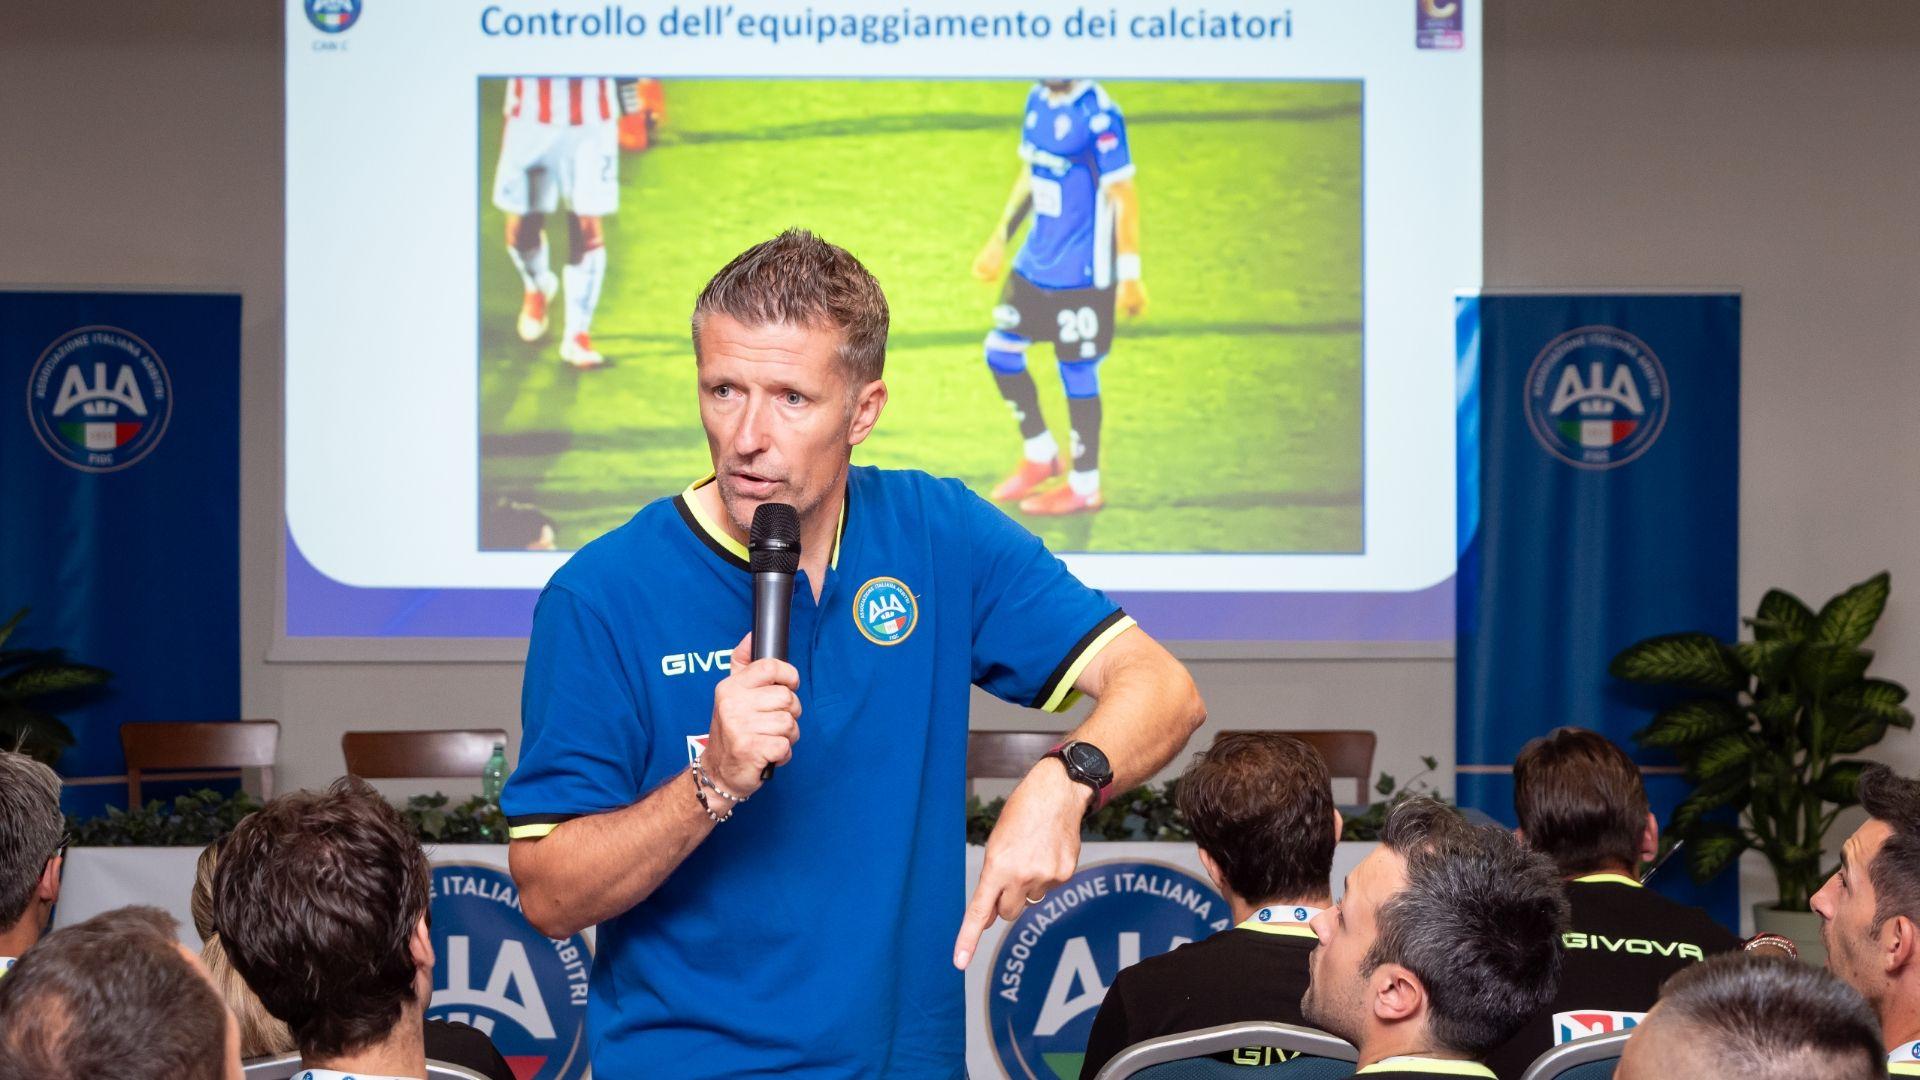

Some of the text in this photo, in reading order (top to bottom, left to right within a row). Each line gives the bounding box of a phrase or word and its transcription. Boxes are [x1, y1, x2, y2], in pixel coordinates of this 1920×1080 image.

[480, 6, 646, 37] Controllo
[1064, 9, 1117, 38] dei
[1129, 9, 1292, 39] calciatori
[1057, 306, 1098, 342] 20
[52, 362, 148, 416] AIA
[1549, 362, 1645, 416] AIA
[869, 594, 907, 624] AIA
[661, 649, 734, 676] GIVO
[1000, 873, 1213, 1003] ASSOCIAZIONE ITALIANA
[1562, 932, 1704, 962] GIVOVA
[550, 937, 588, 1006] RBITRI
[1033, 932, 1193, 1036] AI
